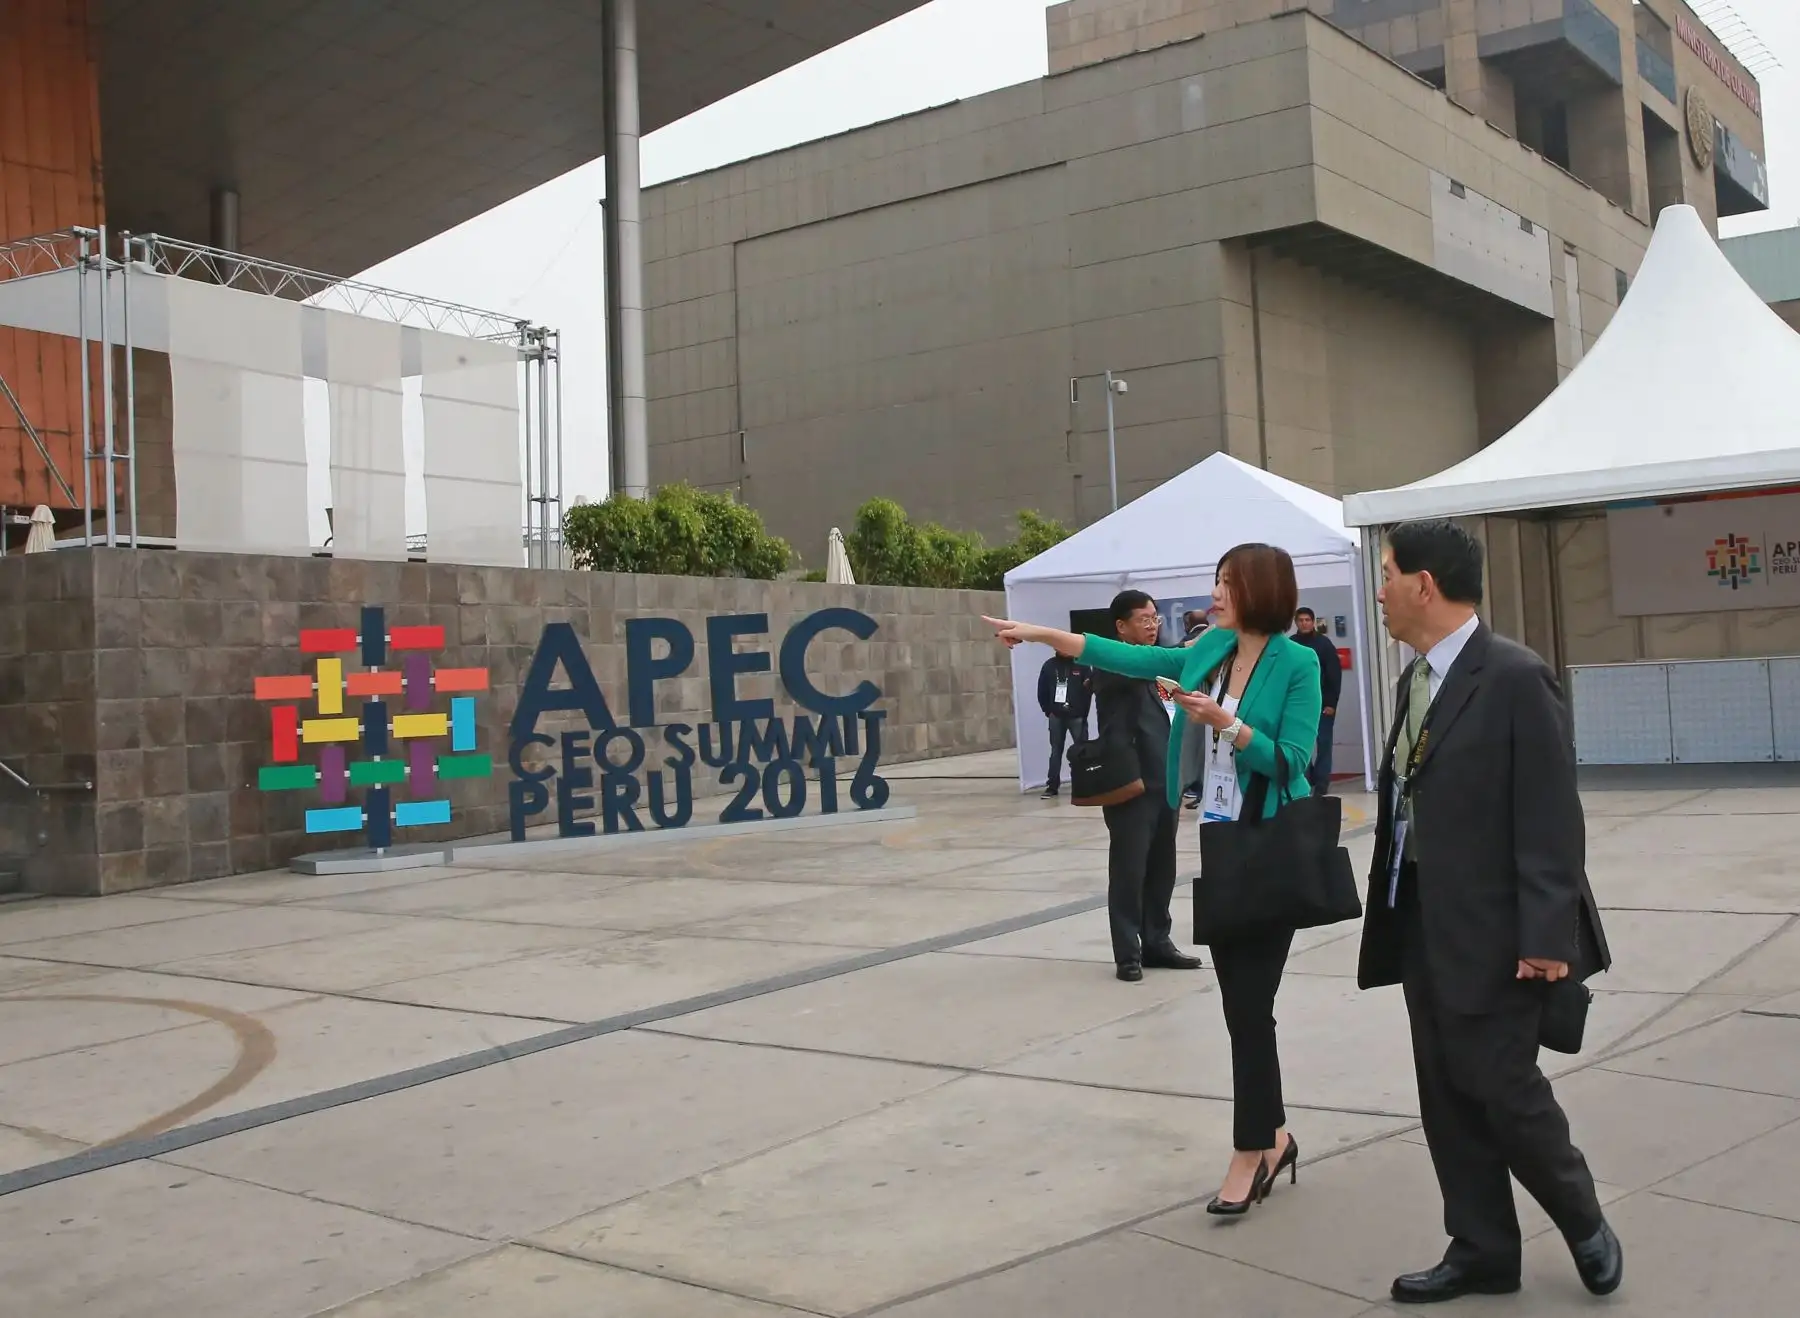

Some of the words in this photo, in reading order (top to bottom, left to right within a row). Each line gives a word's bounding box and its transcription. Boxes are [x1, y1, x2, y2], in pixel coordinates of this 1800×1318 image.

[1772, 541, 1800, 558] AP
[1772, 557, 1791, 566] CEO
[1773, 565, 1797, 575] PERU
[511, 608, 882, 734] APEC
[508, 727, 646, 781] CEO
[664, 710, 887, 769] SUMMIT
[508, 767, 694, 842] PERU
[719, 754, 890, 823] 2016
